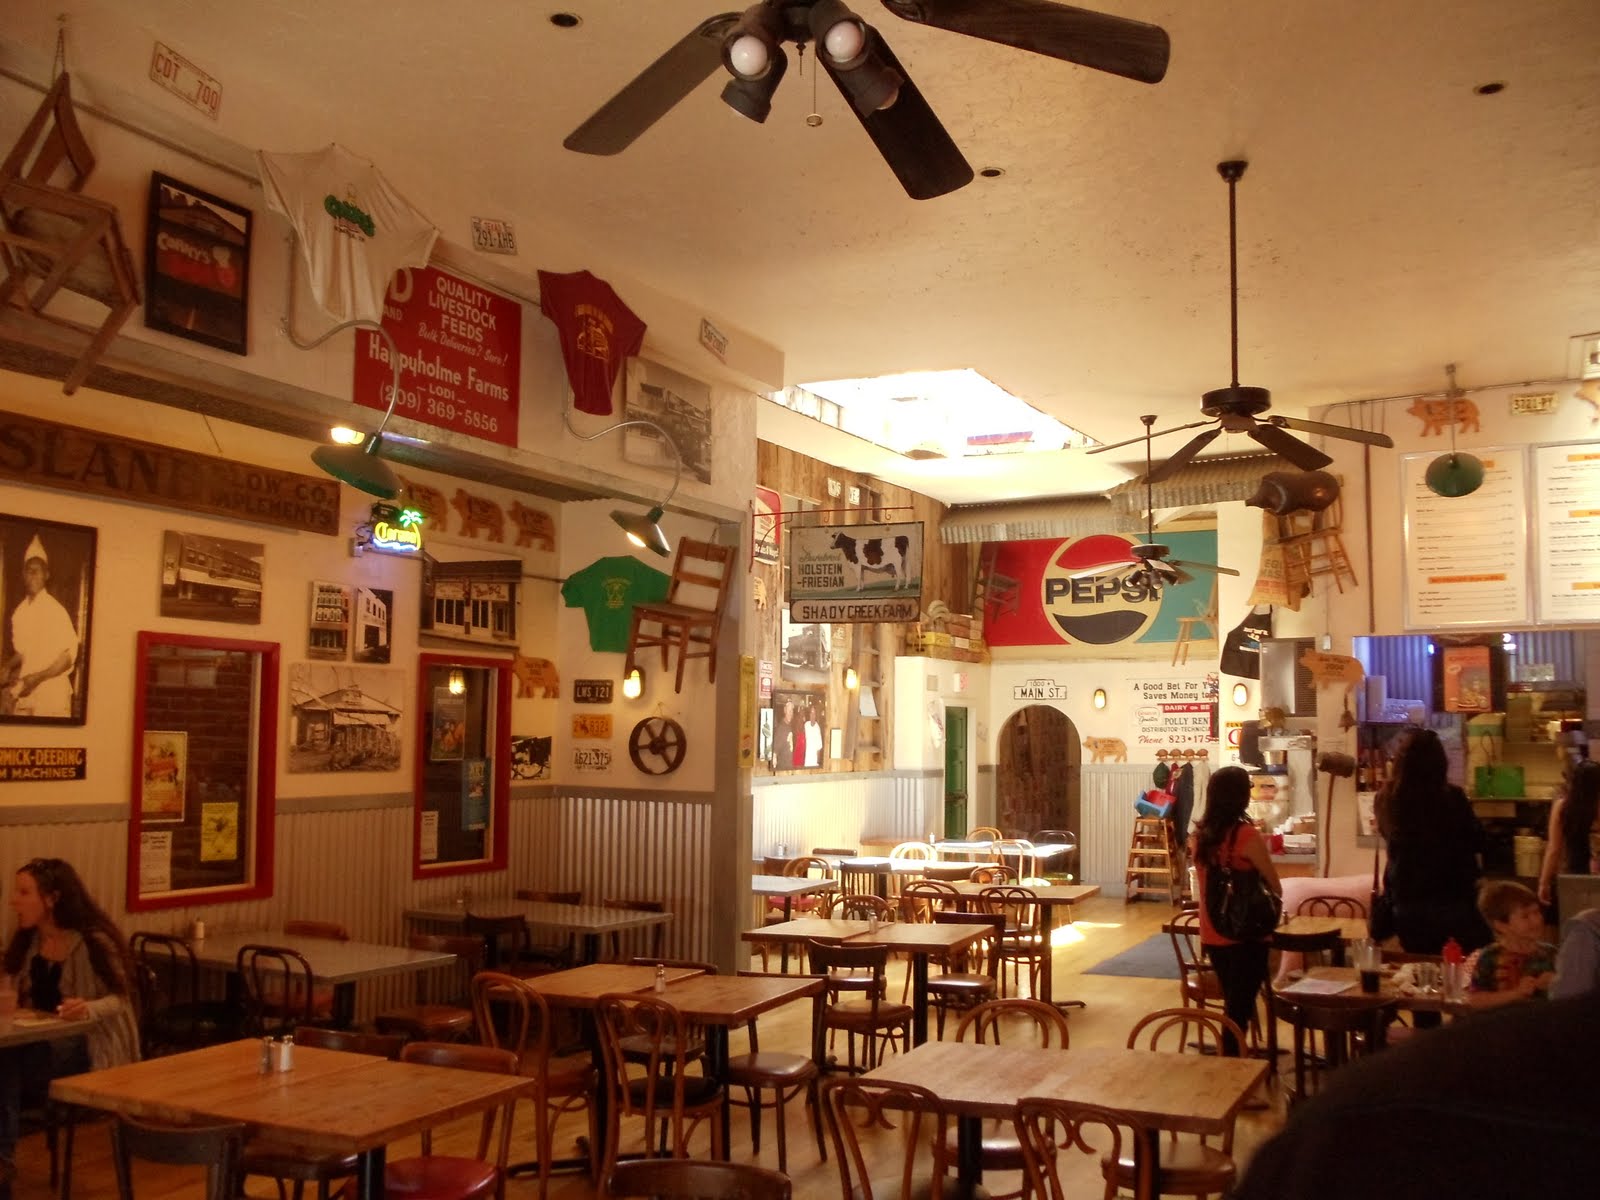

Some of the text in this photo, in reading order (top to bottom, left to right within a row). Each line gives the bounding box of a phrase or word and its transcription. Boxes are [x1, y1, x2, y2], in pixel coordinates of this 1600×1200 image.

[436, 275, 492, 309] QUALITY
[428, 289, 497, 331] LIVESTOCK
[417, 321, 438, 342] Bulk
[441, 314, 484, 343] FEEDS
[467, 365, 510, 402] Farms
[428, 384, 456, 400] LODI
[379, 380, 499, 433] (209) 369-5856
[798, 563, 843, 576] HOLSTEIN
[1045, 575, 1159, 605] PEPSI
[802, 604, 912, 619] SHADY CREEK FARM
[1020, 688, 1063, 698] MAIN ST.
[1133, 683, 1140, 691] A
[1143, 683, 1163, 691] Good
[1166, 682, 1181, 690] Bet
[1185, 682, 1198, 690] For
[1143, 692, 1167, 700] Saves
[1170, 691, 1199, 701] Money
[1164, 717, 1189, 726] POLLY
[1138, 735, 1163, 744] Phone
[11, 768, 77, 778] MACHINES
